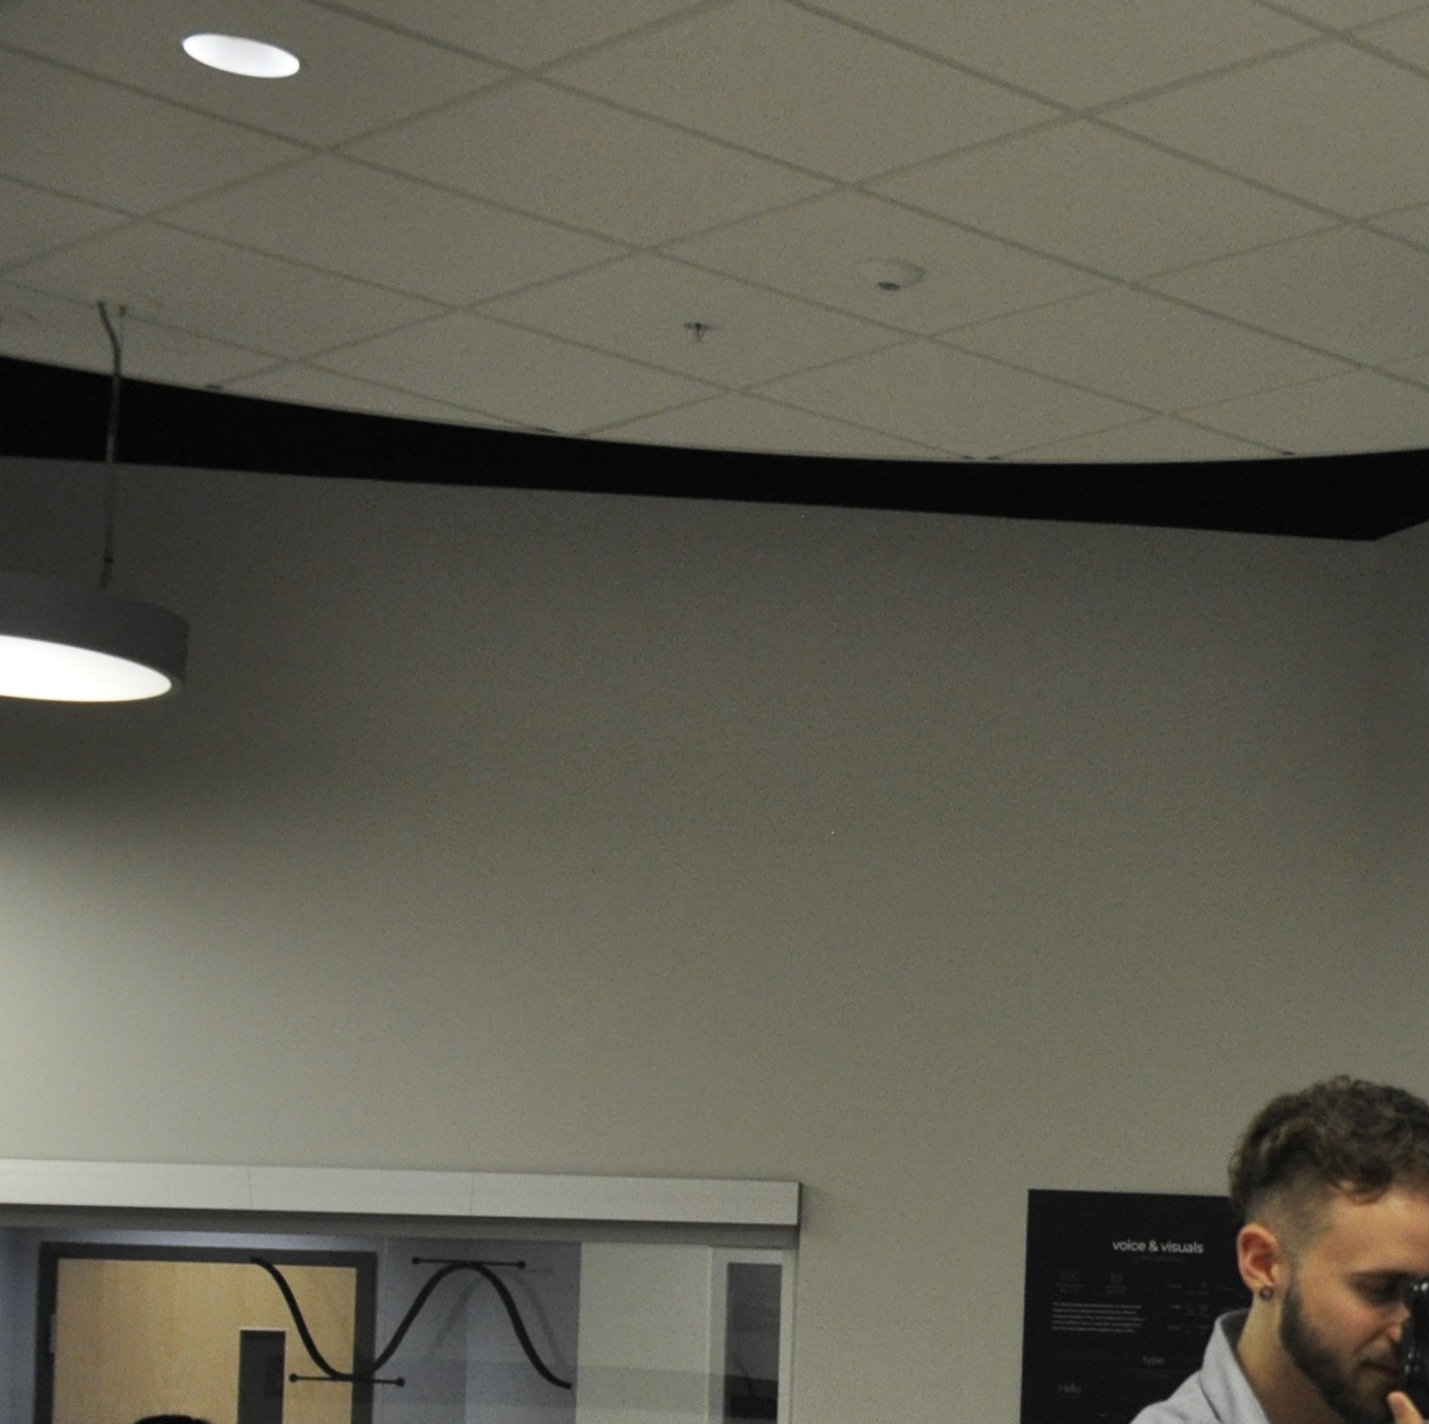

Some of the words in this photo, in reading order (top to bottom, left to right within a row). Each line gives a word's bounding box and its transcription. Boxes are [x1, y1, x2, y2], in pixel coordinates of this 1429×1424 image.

[1112, 1239, 1146, 1253] voice
[1148, 1239, 1159, 1253] &
[1160, 1240, 1205, 1255] visuals
